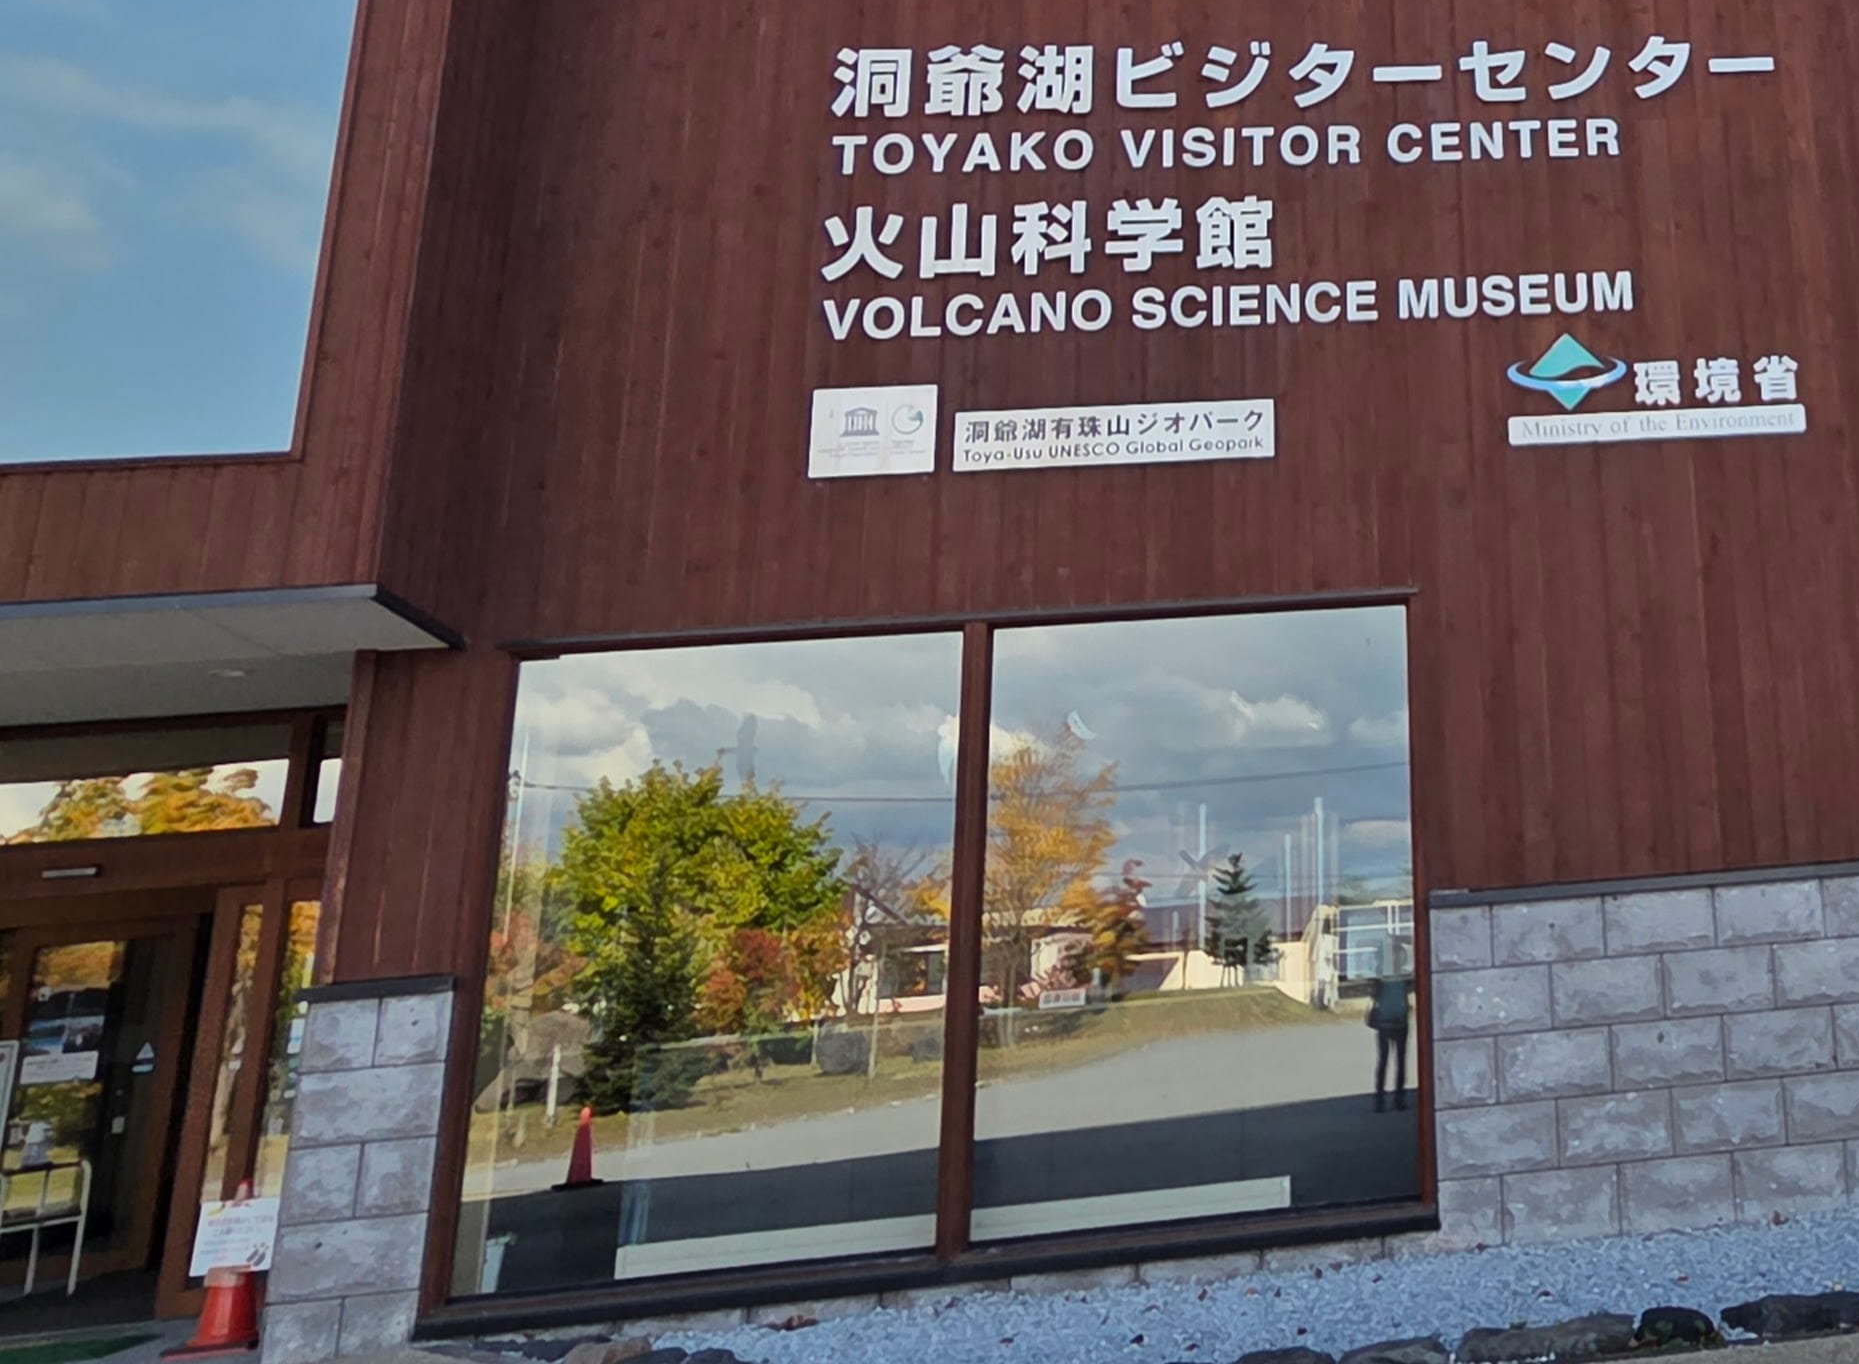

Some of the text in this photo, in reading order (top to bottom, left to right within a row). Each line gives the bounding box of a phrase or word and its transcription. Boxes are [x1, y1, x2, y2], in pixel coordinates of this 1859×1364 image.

[830, 35, 1776, 118] 洞爺湖ビジターセンター
[831, 117, 1620, 176] TOYAKO VISITOR CENTER
[820, 195, 1273, 282] 火山科学館
[822, 269, 1634, 341] VOLCANO SCIENCE MUSEUM
[1633, 355, 1799, 405] 環境省
[963, 436, 1265, 464] Toya-Usu UNESCO Global Geopark
[964, 409, 1265, 443] 洞爺湖有珠山ジオパーク
[1521, 409, 1795, 438] Ministry of the Environment
